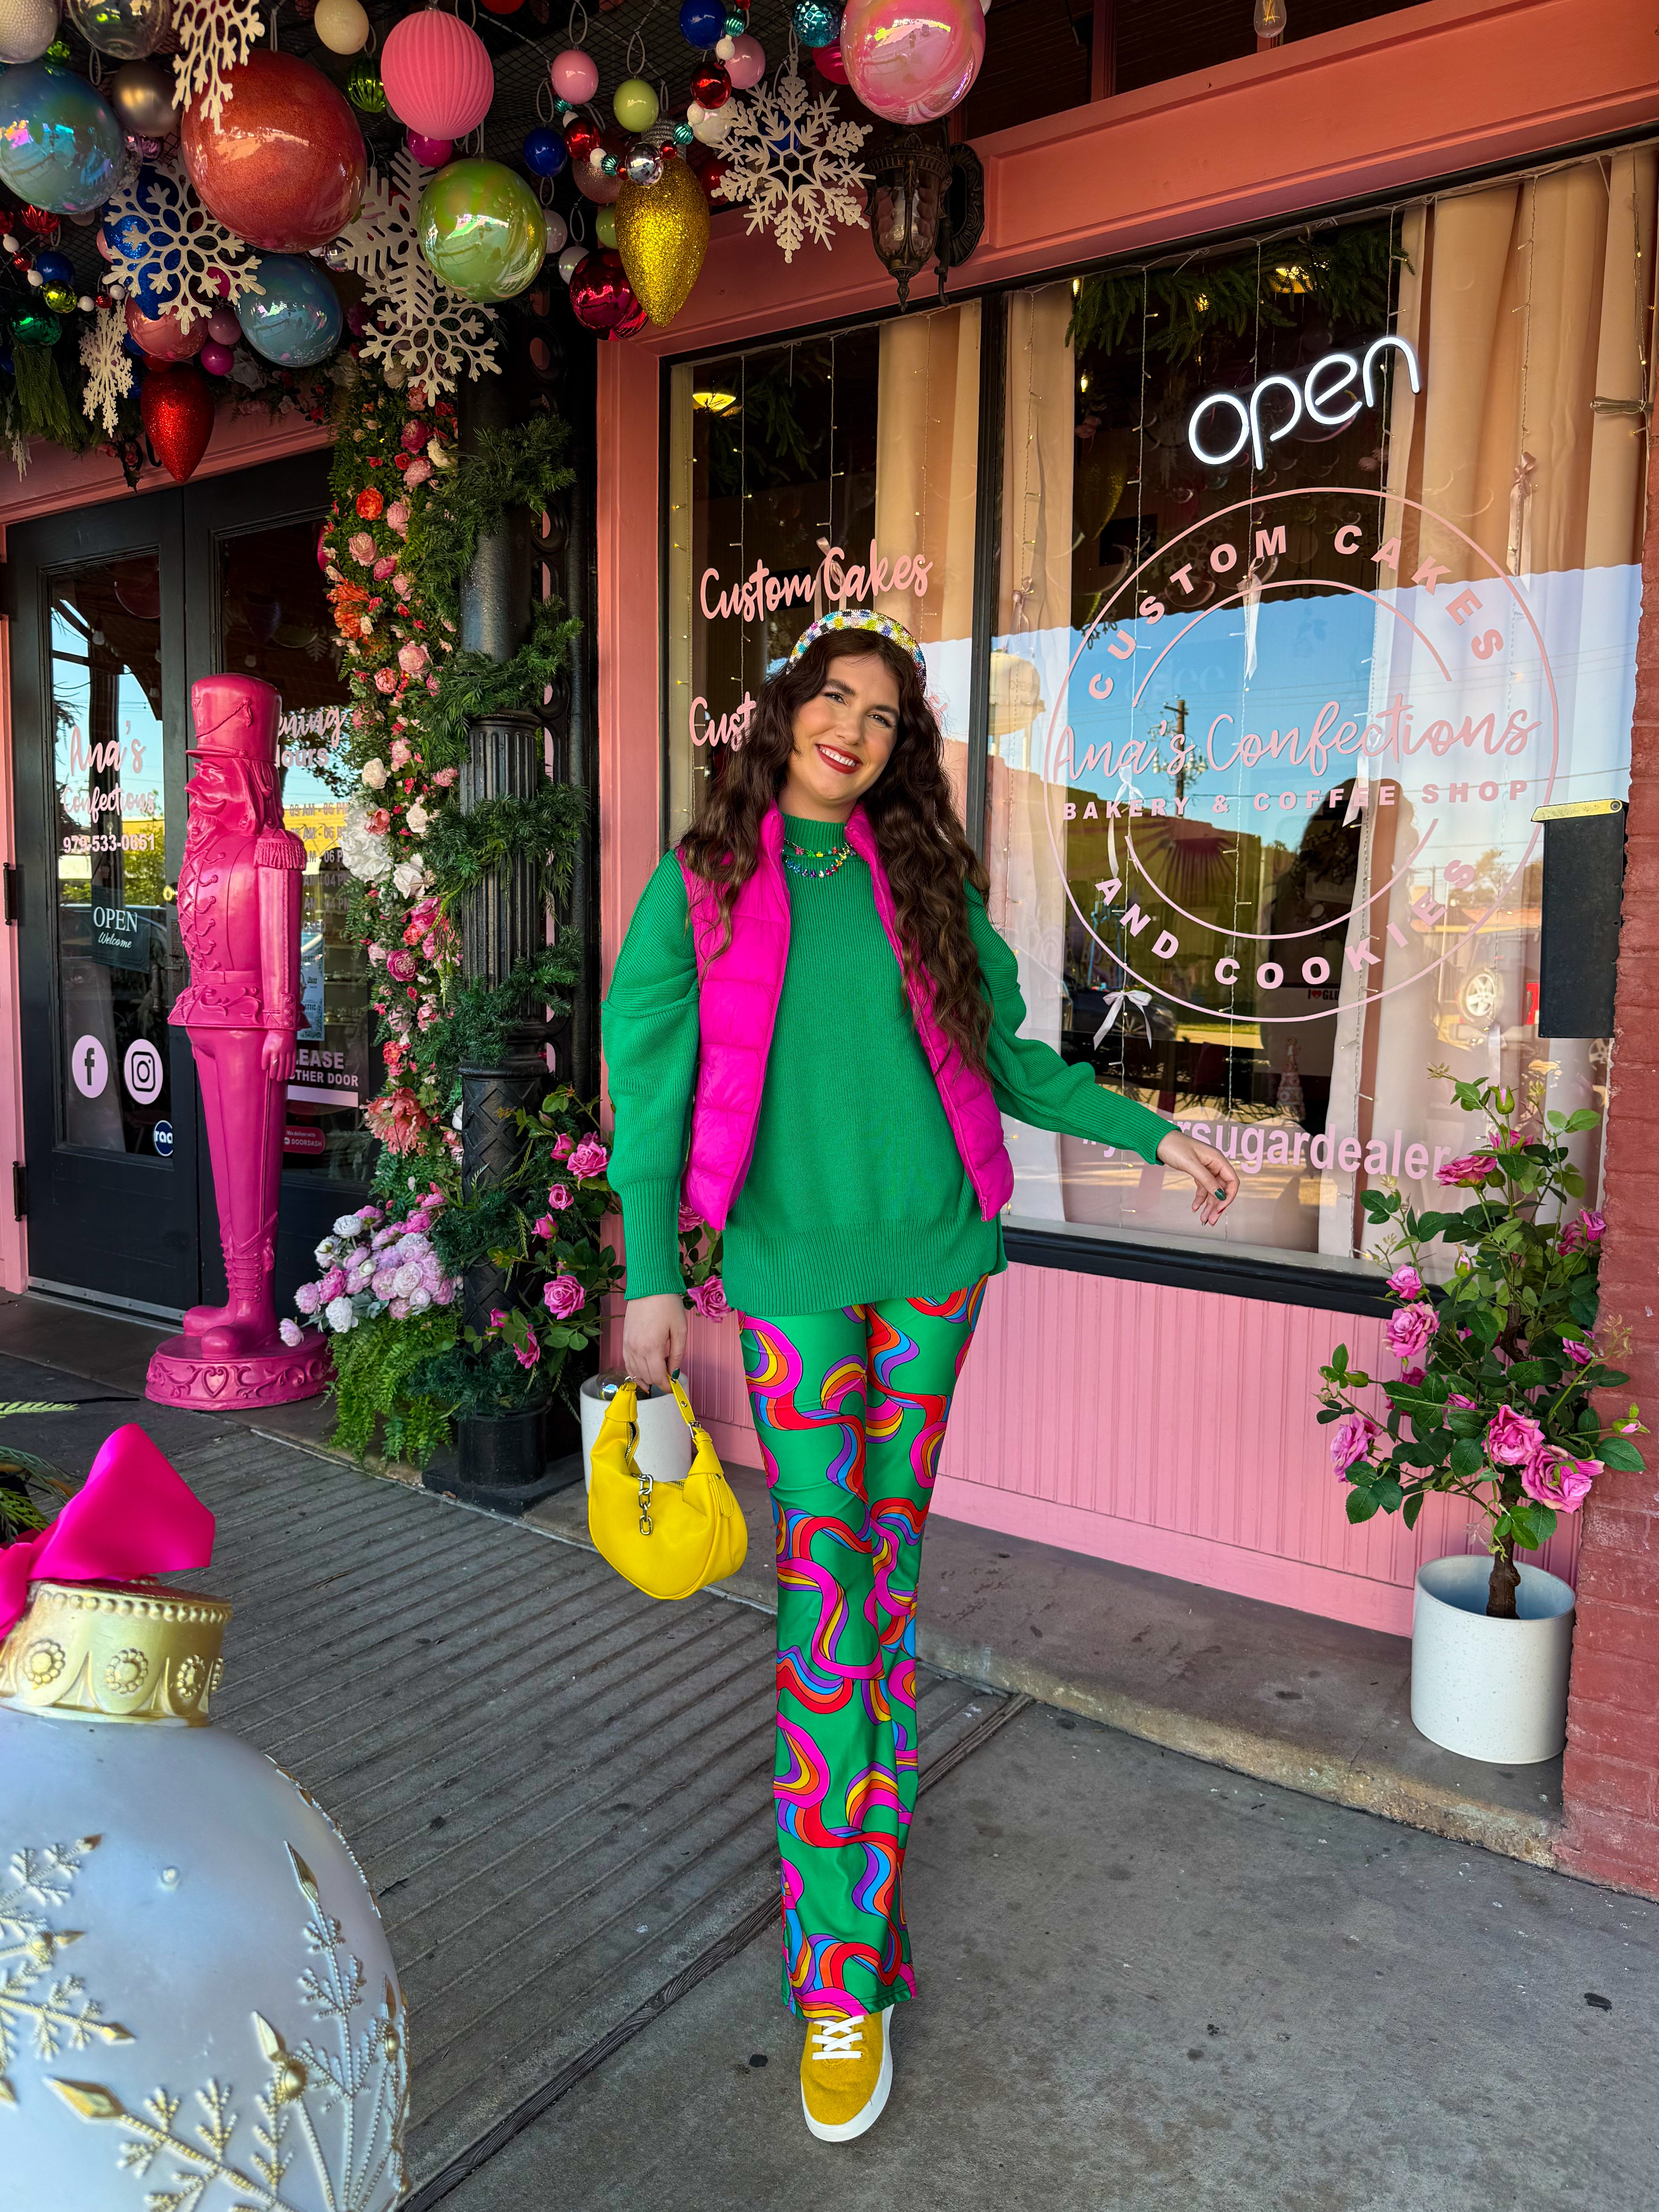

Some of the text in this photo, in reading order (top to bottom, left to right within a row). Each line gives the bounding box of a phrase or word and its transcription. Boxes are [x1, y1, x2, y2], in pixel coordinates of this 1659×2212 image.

[1188, 336, 1421, 470] open
[700, 538, 933, 622] Custom Cakes
[1088, 524, 1504, 700] CUSTOM CAKES
[689, 691, 757, 752] Cust
[1053, 693, 1542, 783] Ana's Confections
[70, 720, 146, 777] Ana's
[63, 782, 157, 824] Confections
[1063, 780, 1528, 820] BAKERY & COFFEE SHOP
[63, 833, 155, 854] 979-533-0651
[324, 850, 335, 863] 06
[93, 906, 138, 933] OPEN
[98, 931, 132, 948] Welcome
[1095, 859, 1476, 990] AND COOKIES
[296, 1048, 344, 1070] EASE
[327, 1072, 358, 1086] DOOR
